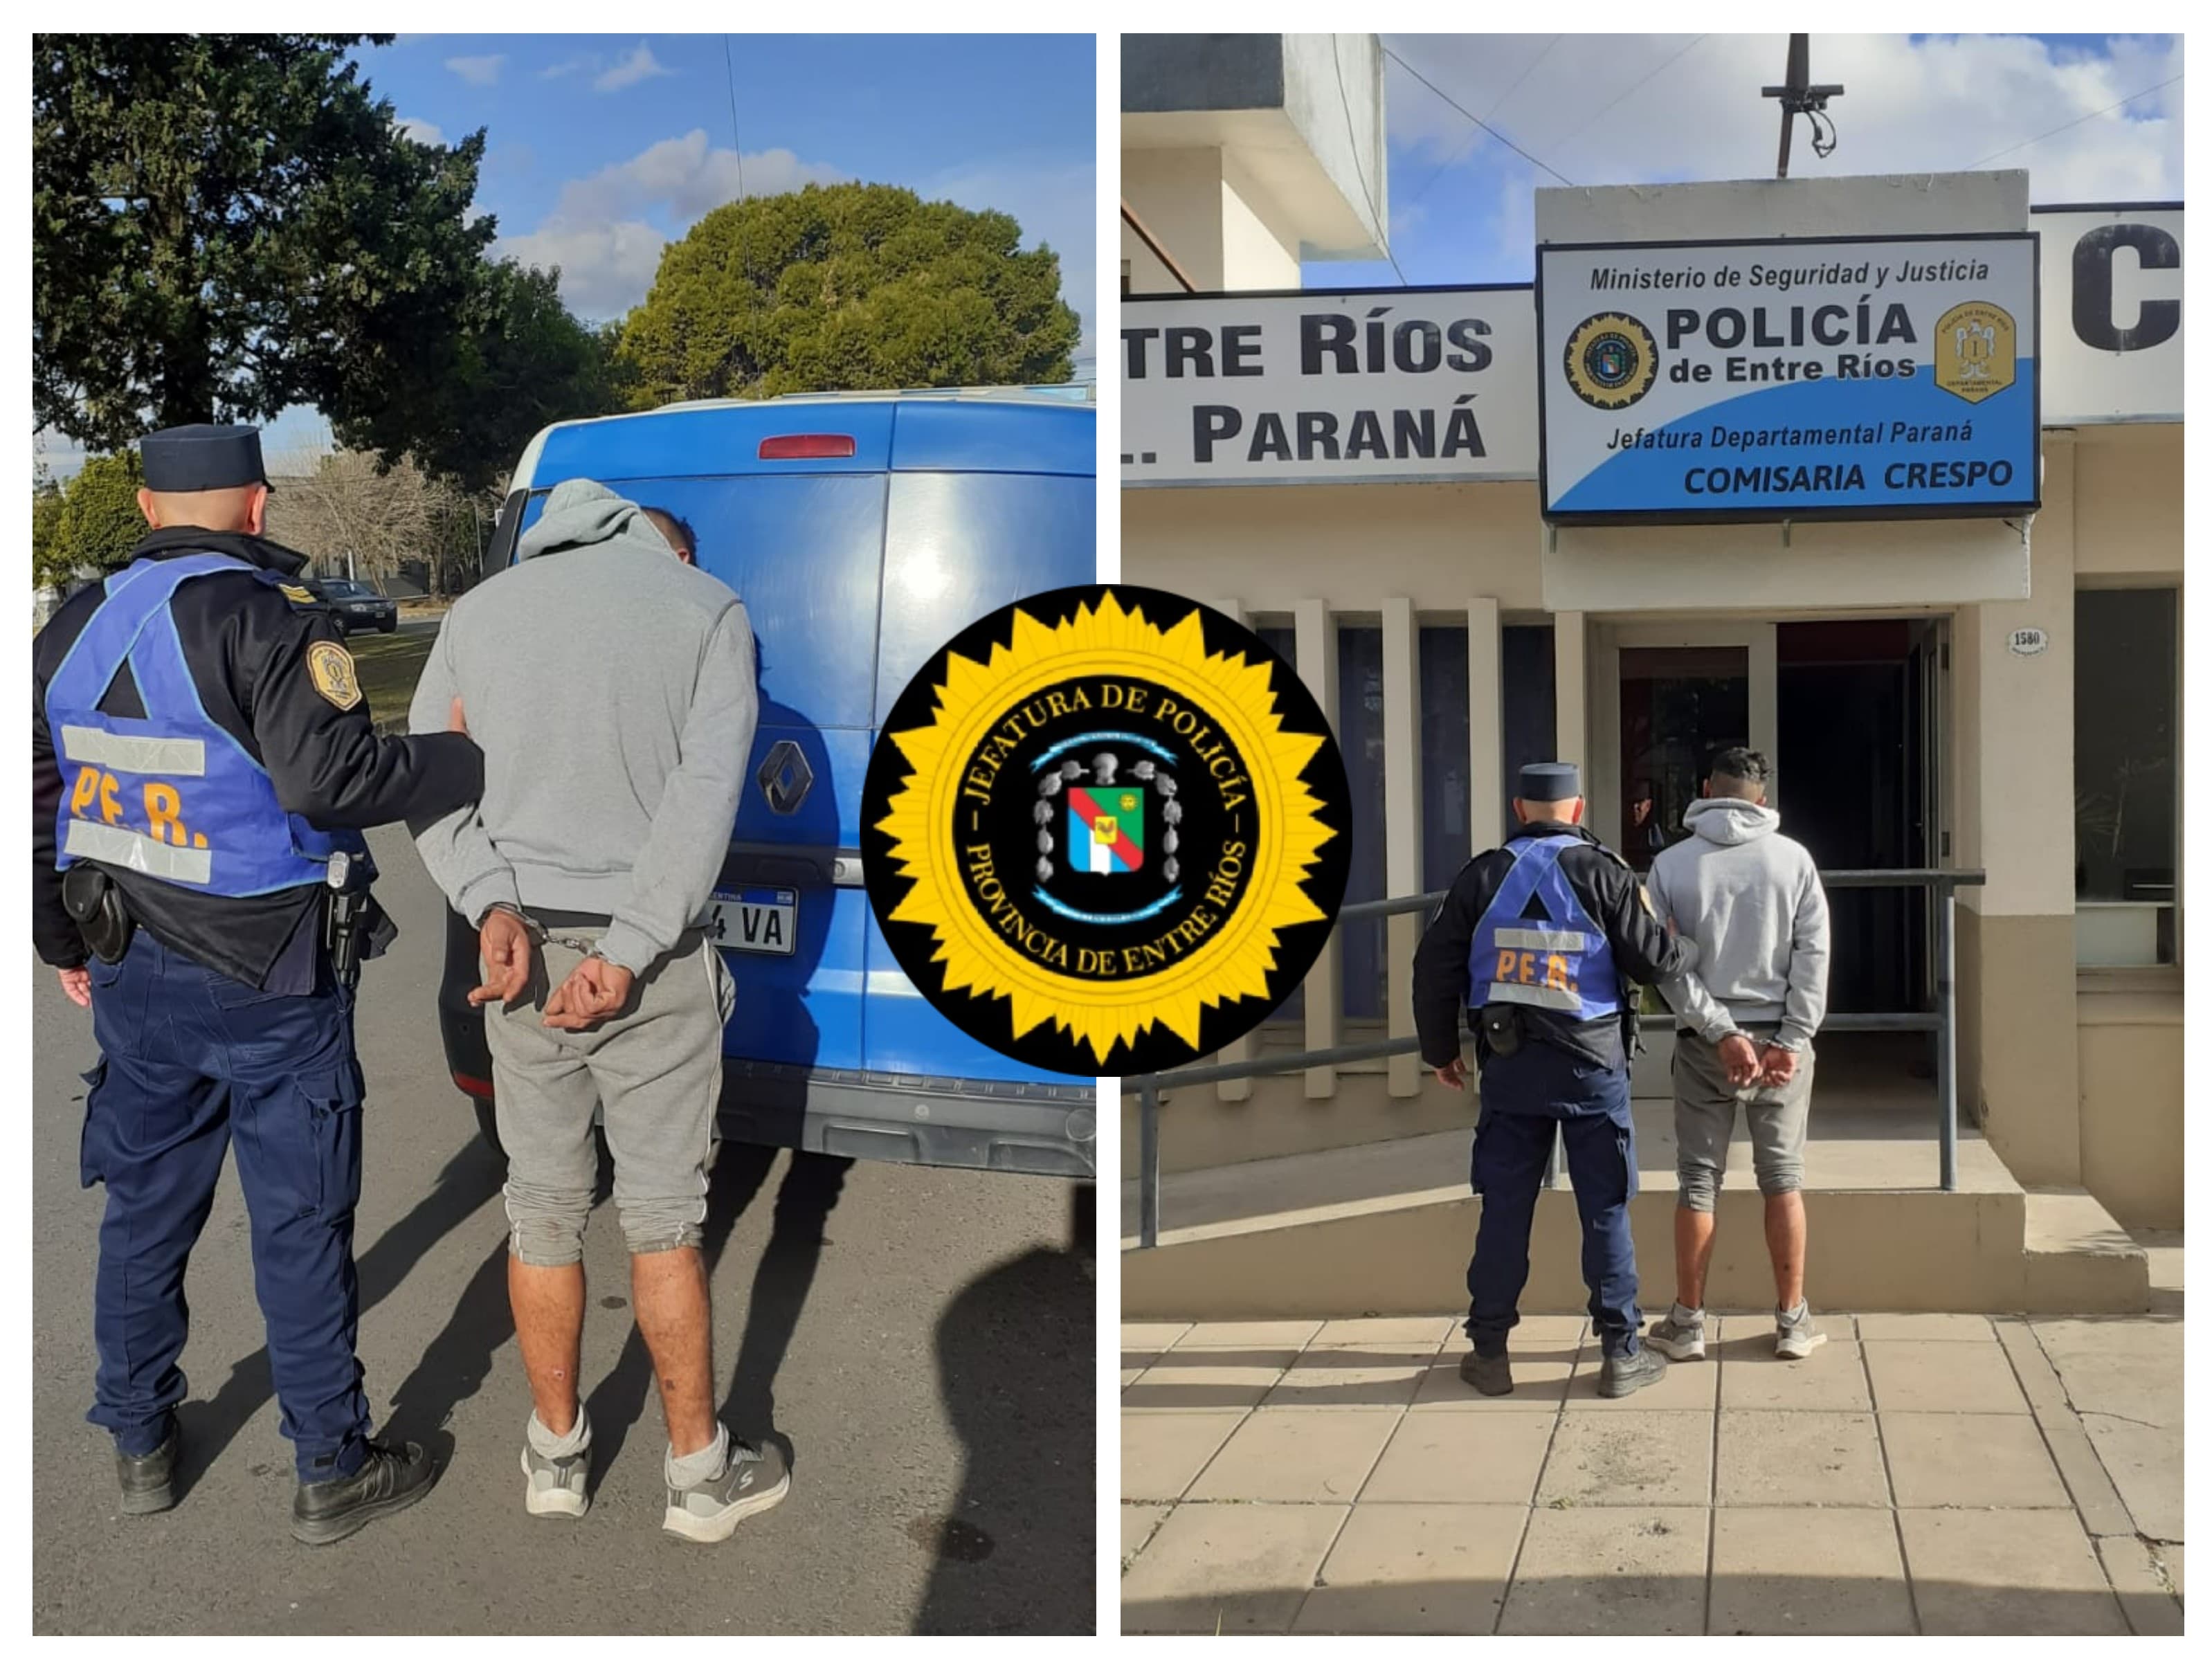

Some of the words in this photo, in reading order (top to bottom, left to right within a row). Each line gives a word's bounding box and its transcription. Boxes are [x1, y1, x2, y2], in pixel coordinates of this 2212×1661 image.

[1590, 266, 1705, 290] Ministerio
[1714, 266, 1741, 287] de
[1749, 262, 1869, 291] Seguridad
[1874, 266, 1889, 289] y
[1896, 259, 1988, 282] Justicia
[1667, 294, 1917, 349] POLICÍA
[1669, 358, 1712, 383] de
[1727, 356, 1823, 381] Entre
[1838, 353, 1916, 379] Ríos
[1193, 394, 1487, 463] PARANÁ
[1607, 428, 1703, 449] Jefatura
[1711, 423, 1883, 451] Departamental
[1890, 419, 1973, 443] Paraná
[1685, 464, 1865, 494] COMISARIA
[1885, 460, 2013, 489] CRESPO
[2015, 631, 2040, 646] 1580
[71, 766, 208, 849] PER.
[742, 907, 782, 945] VA
[1496, 950, 1577, 992] PER.
